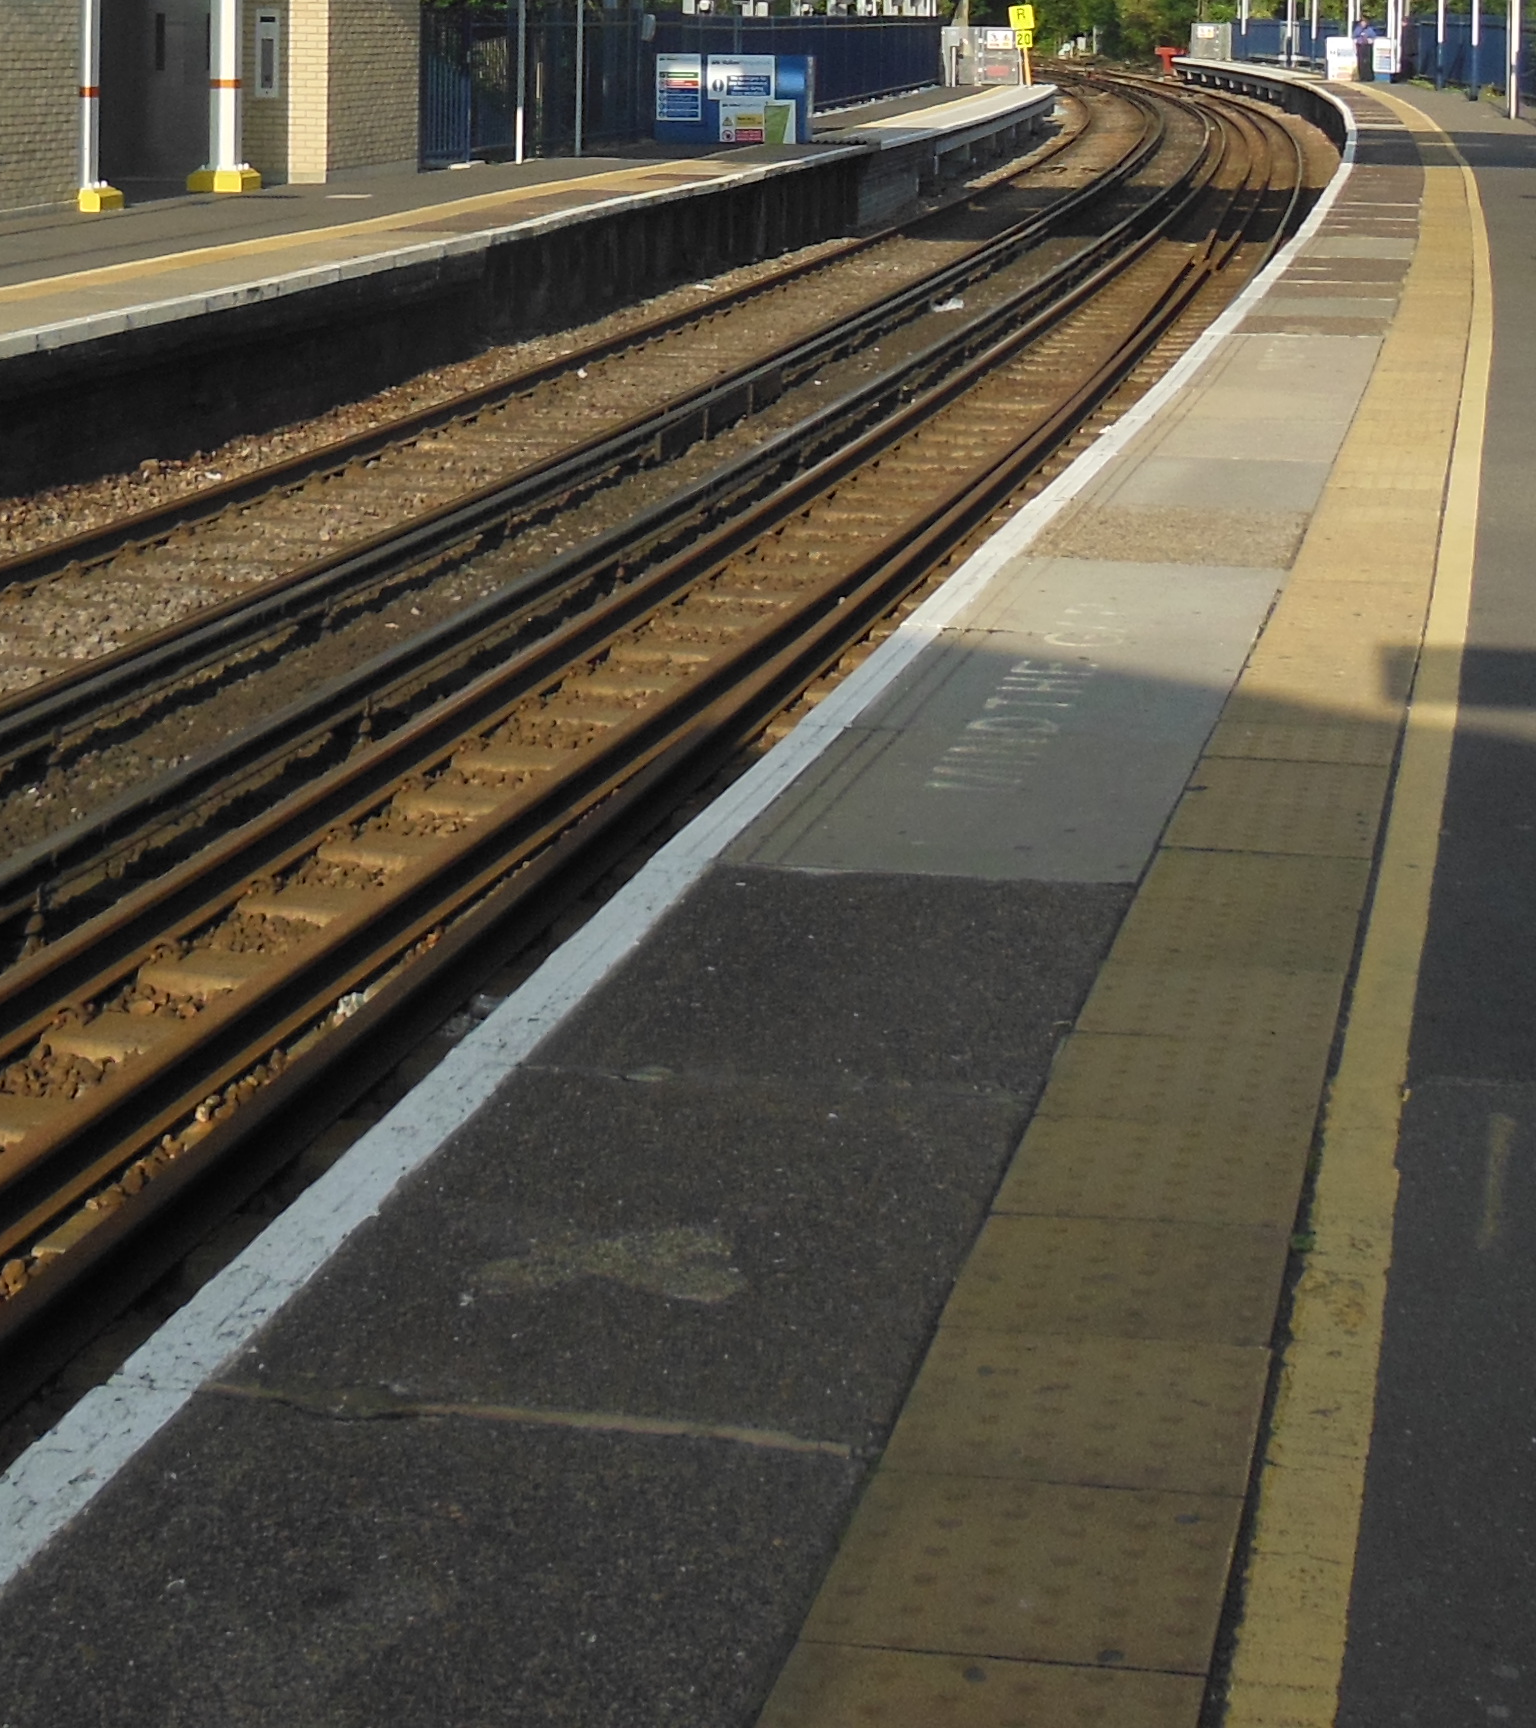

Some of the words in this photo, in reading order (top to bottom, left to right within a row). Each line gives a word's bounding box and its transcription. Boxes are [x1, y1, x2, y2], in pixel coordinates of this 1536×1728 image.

[1017, 8, 1025, 19] R
[1017, 34, 1030, 45] 20
[983, 659, 1100, 710] THE
[924, 716, 1060, 791] MIND
